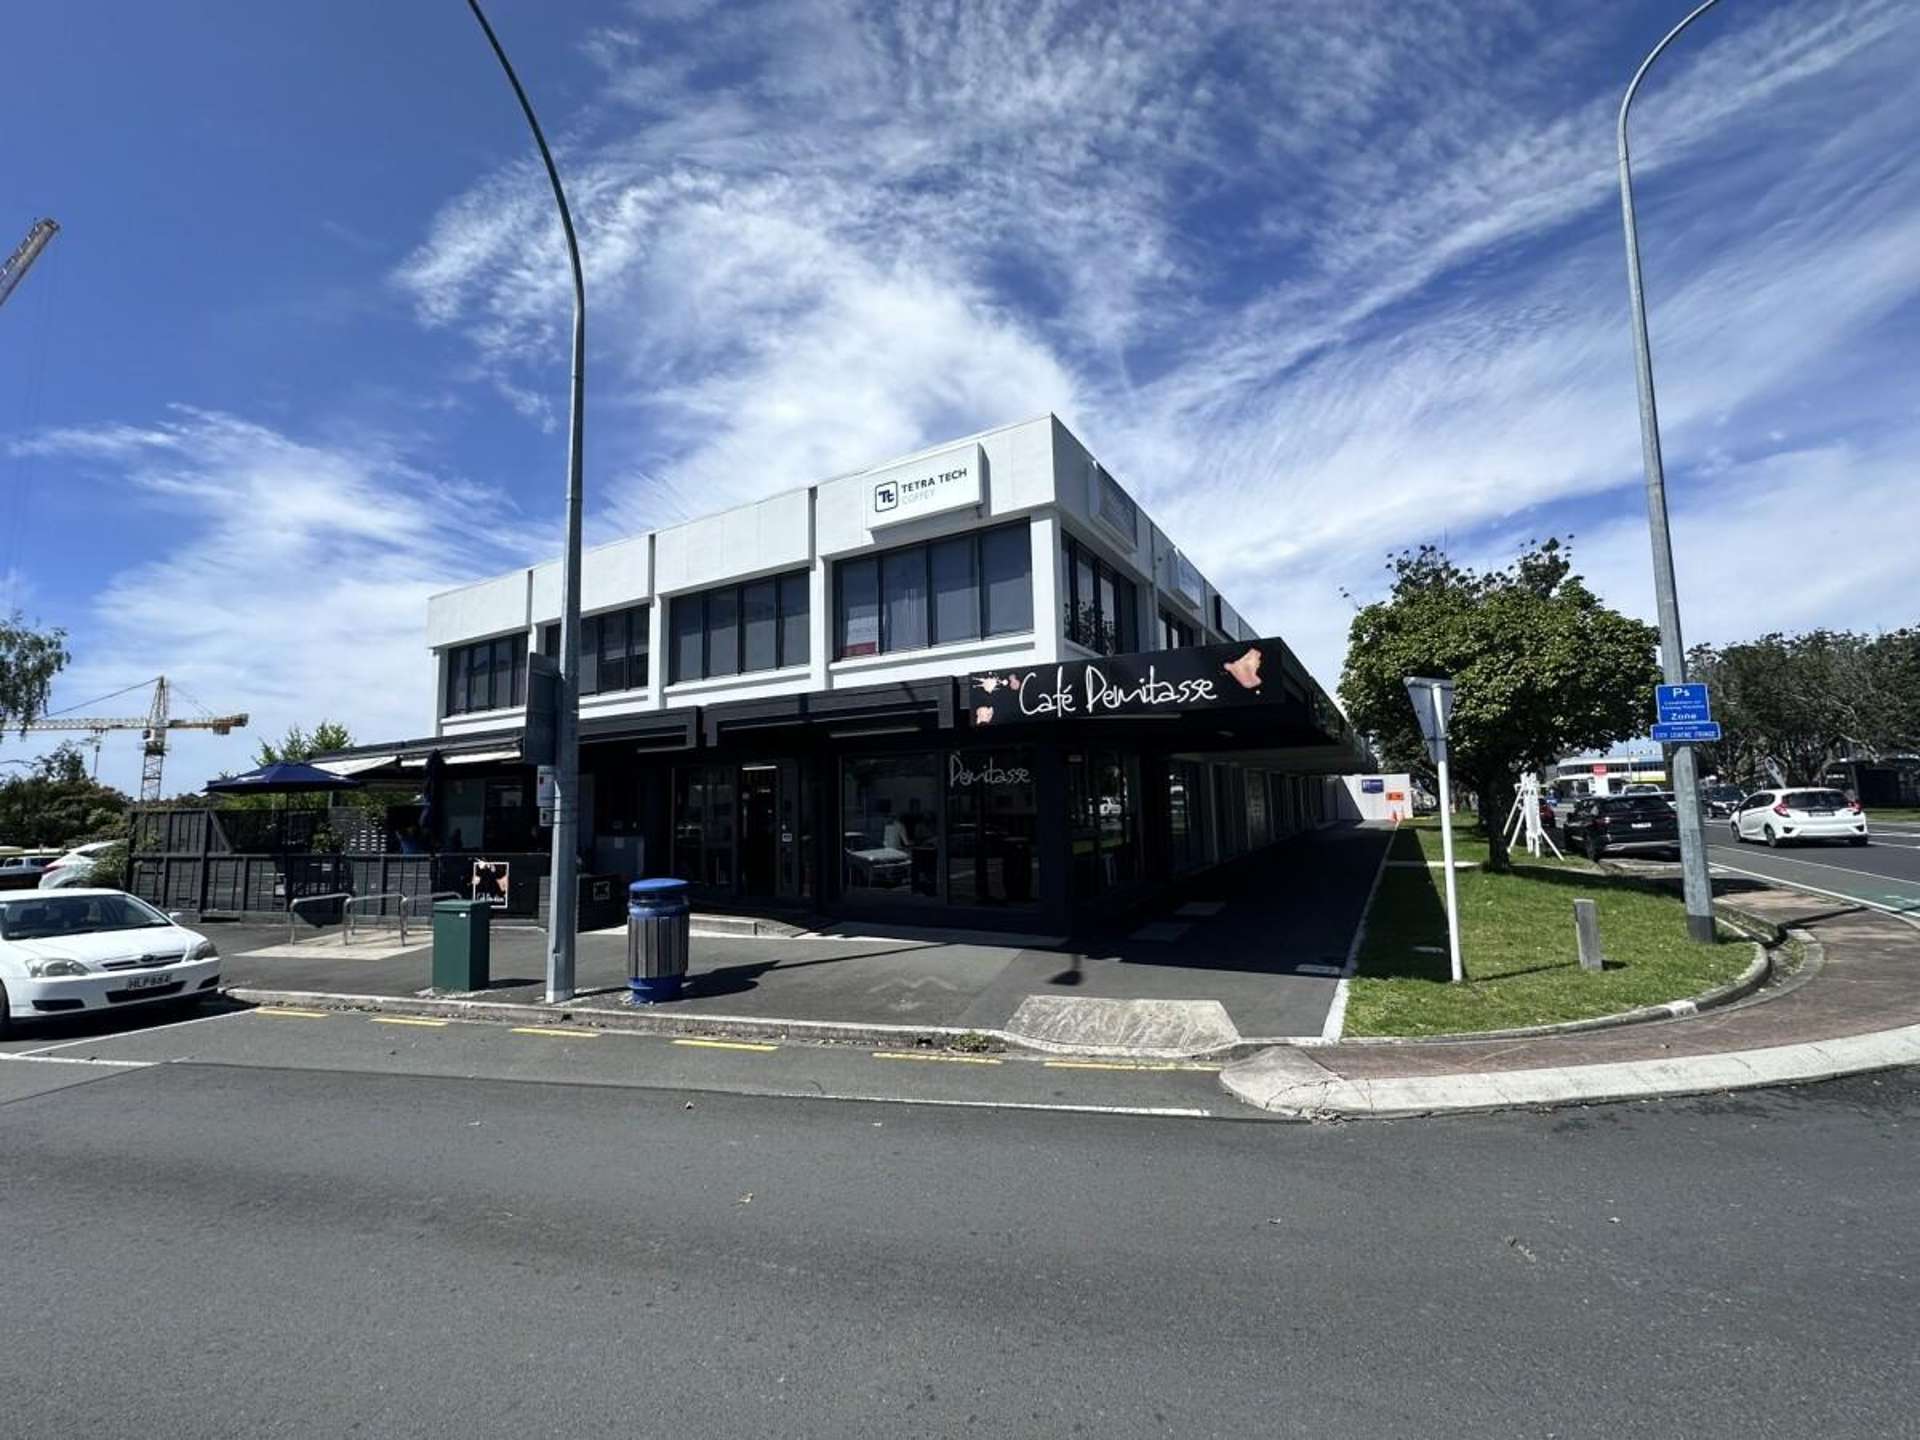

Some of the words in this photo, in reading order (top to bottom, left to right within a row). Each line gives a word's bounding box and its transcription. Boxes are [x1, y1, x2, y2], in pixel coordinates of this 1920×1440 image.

[901, 477, 936, 494] TETRA
[938, 467, 968, 483] TECH
[1018, 665, 1077, 718] Café
[1085, 664, 1219, 714] Demitasse
